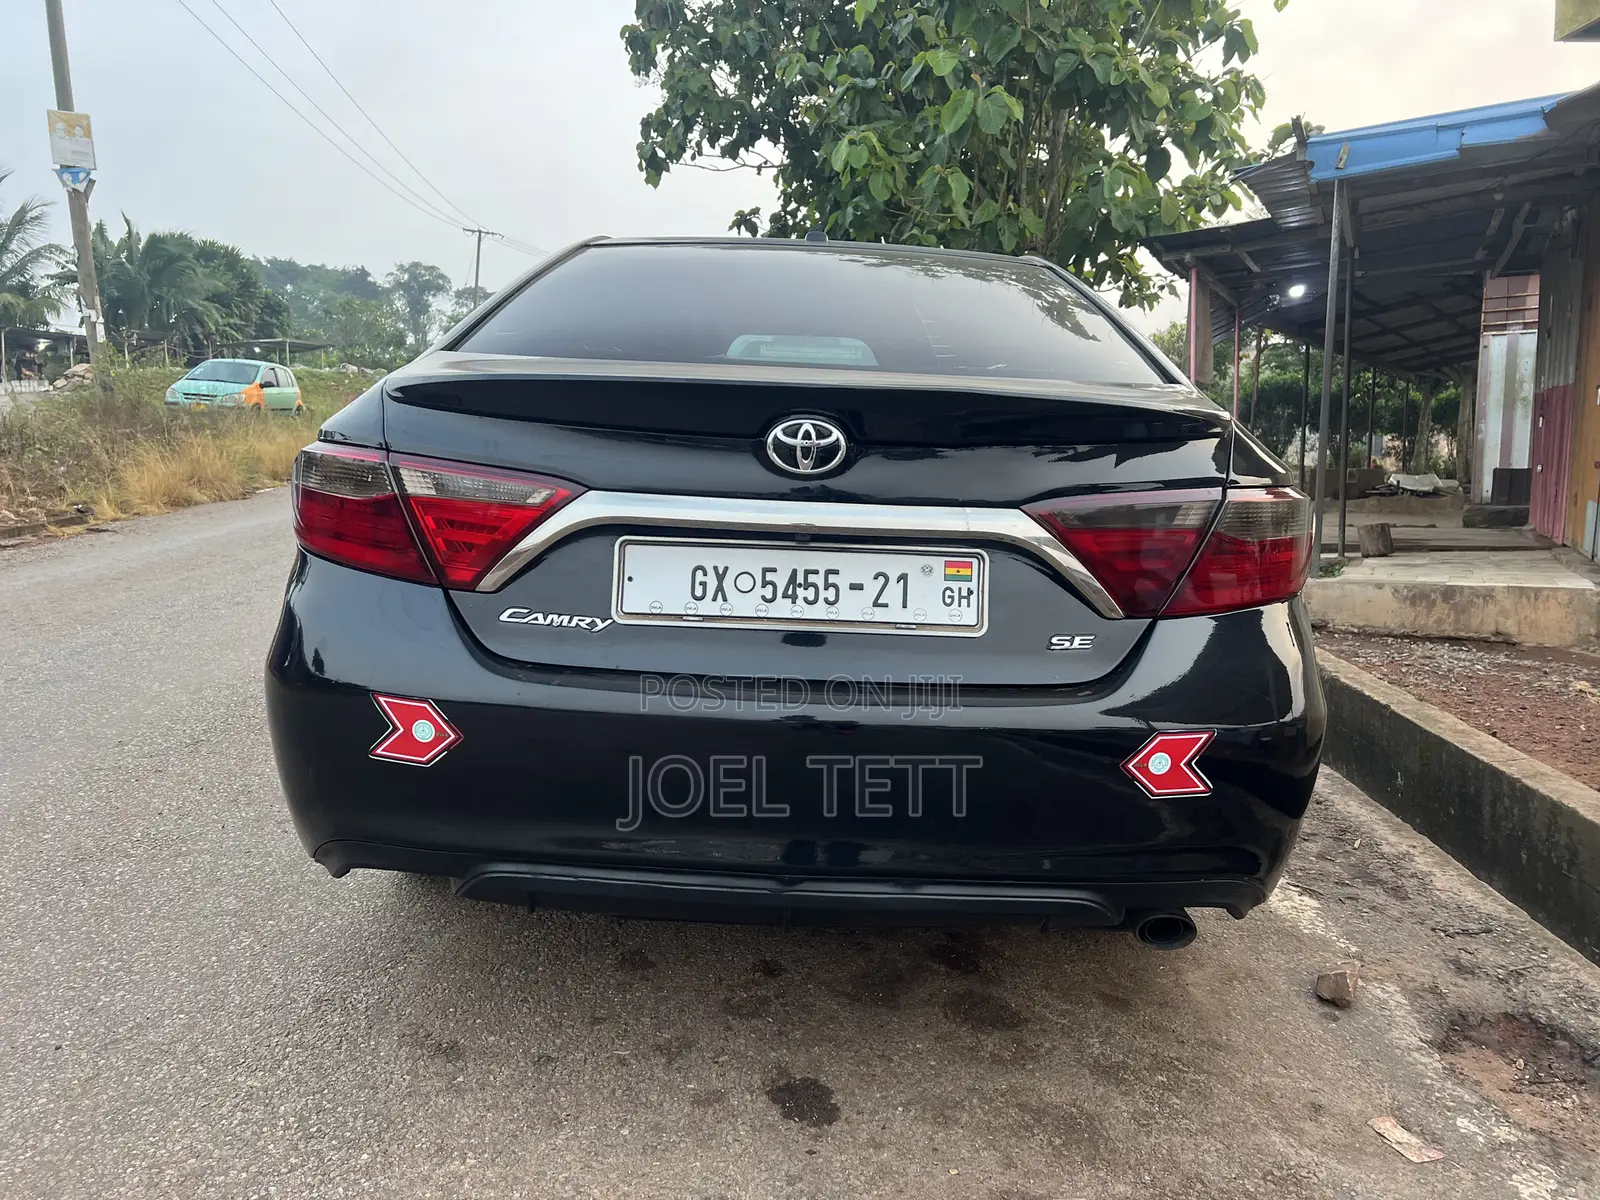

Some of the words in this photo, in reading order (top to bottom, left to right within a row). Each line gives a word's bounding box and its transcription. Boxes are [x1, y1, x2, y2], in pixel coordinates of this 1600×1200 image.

[690, 565, 729, 602] GX
[941, 586, 972, 608] GH
[498, 607, 614, 632] CAMRY
[1049, 634, 1096, 650] SE
